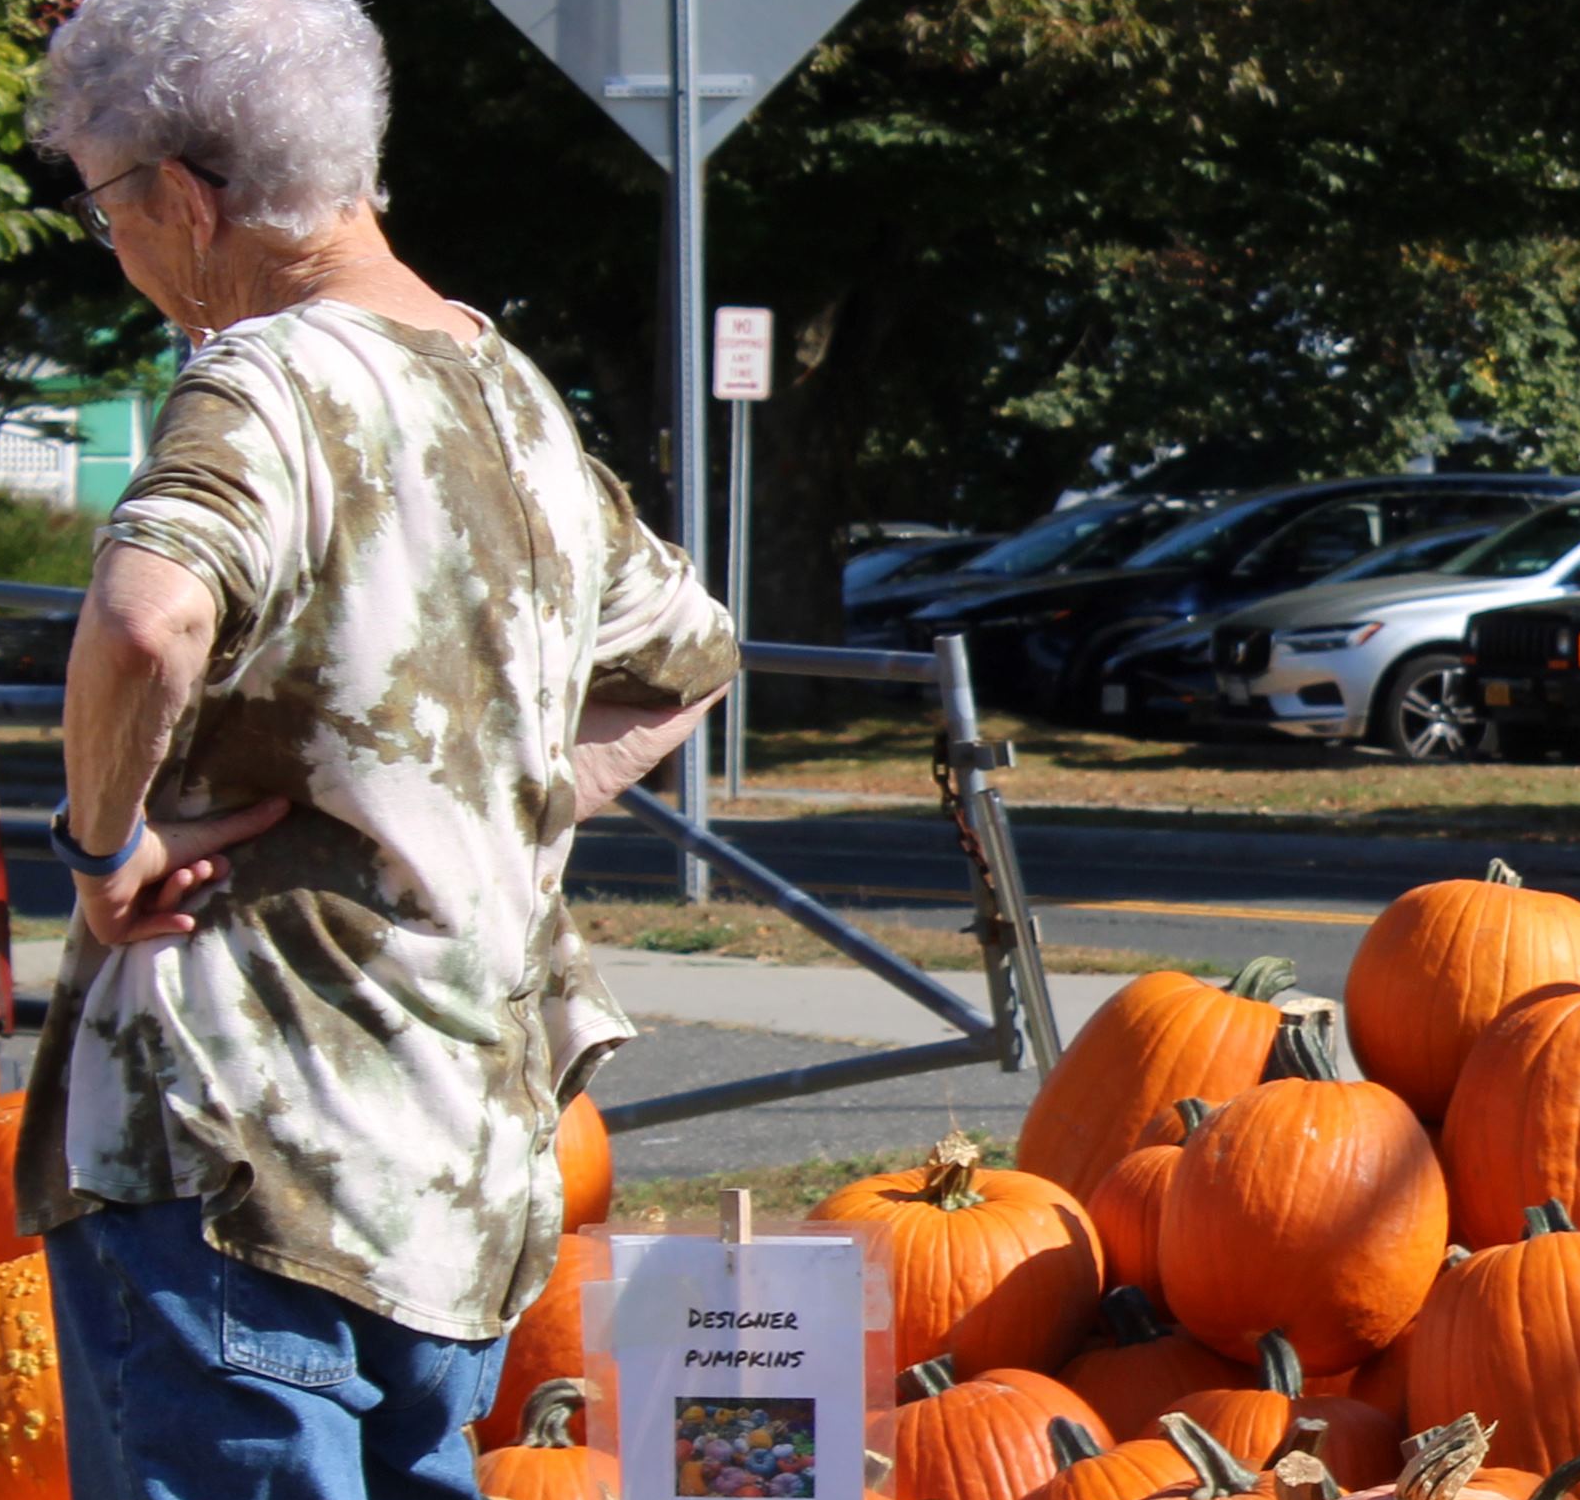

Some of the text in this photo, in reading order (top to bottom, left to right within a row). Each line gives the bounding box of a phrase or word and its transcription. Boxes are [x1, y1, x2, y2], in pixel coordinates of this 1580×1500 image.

[732, 317, 752, 334] NO
[687, 1307, 799, 1330] DESIGNER
[684, 1349, 805, 1369] PUMPKINS
